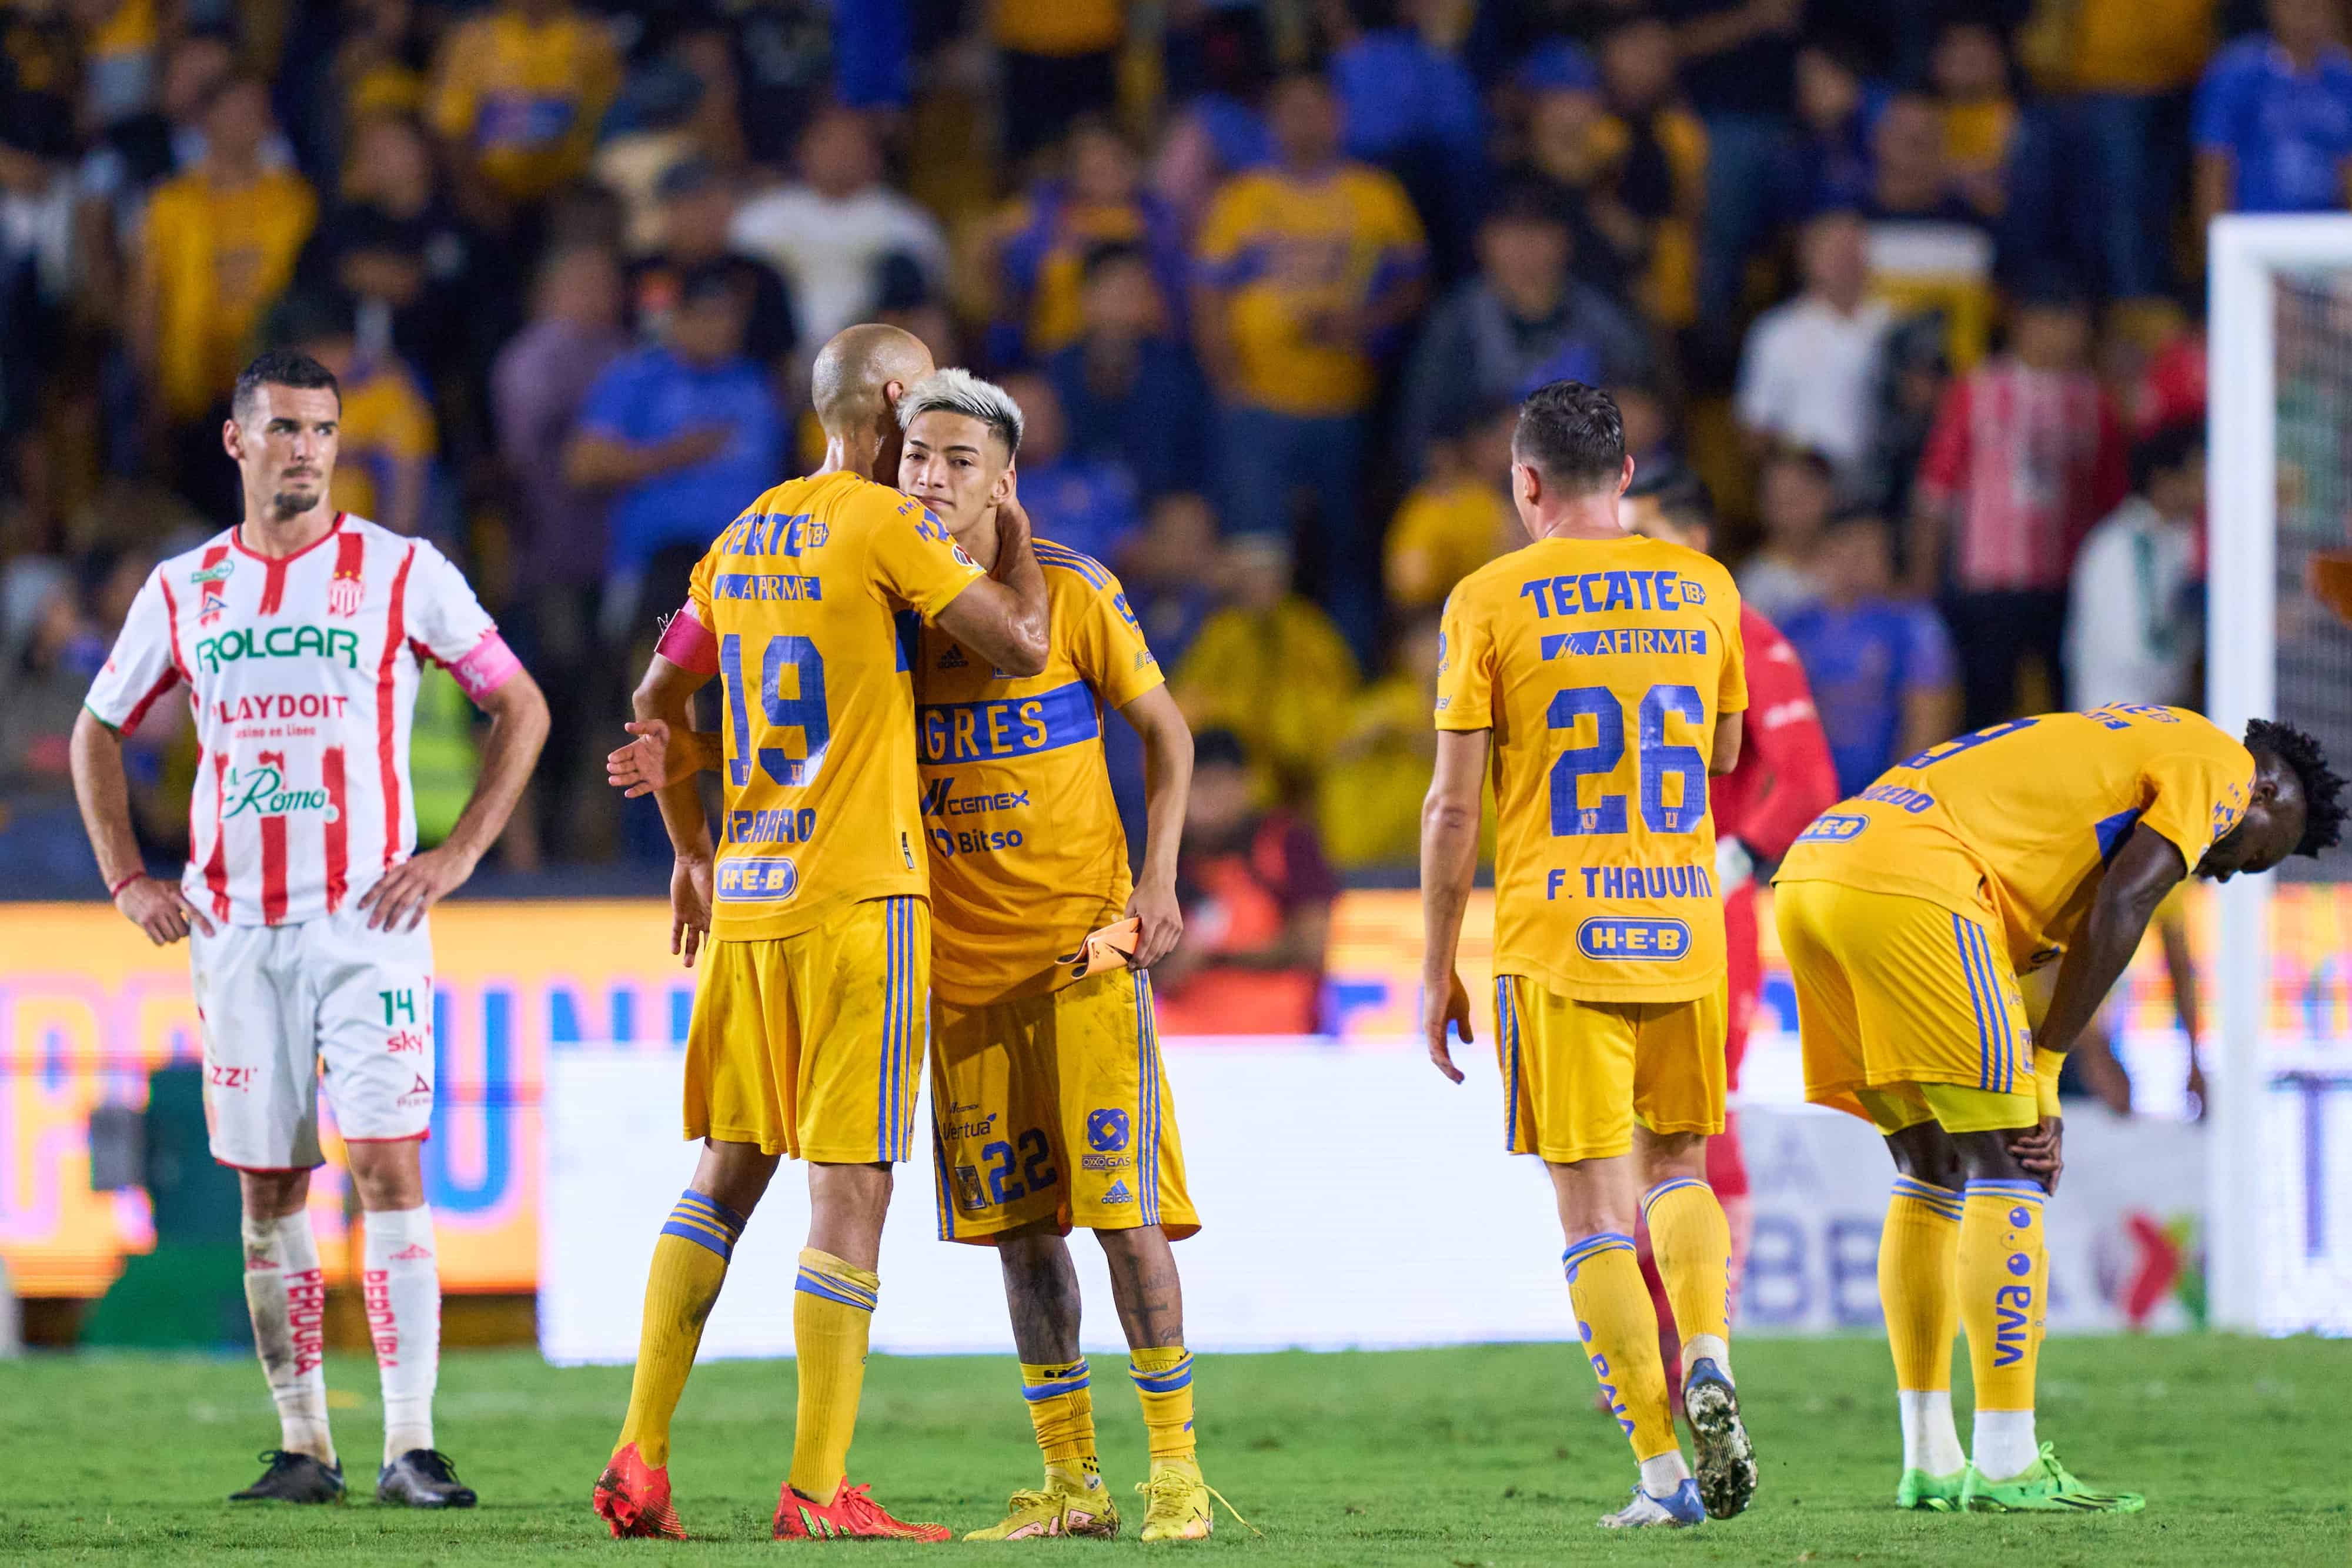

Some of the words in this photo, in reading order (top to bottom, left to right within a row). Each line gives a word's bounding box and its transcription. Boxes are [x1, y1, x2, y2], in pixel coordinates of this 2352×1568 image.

[1521, 571, 1680, 618] TECATE
[1683, 583, 1705, 604] 18+
[196, 625, 359, 674] ROLCAR
[1594, 630, 1699, 655] AFIRME
[213, 694, 349, 724] LAYDOIT
[720, 633, 830, 787] 19
[918, 701, 1048, 761] GRES
[1546, 684, 1705, 837] 26
[947, 790, 1030, 815] CEMEX
[960, 829, 1023, 853] Bitso
[1548, 868, 1573, 900] F.
[1580, 865, 1712, 898] THAUVIN
[379, 988, 415, 1026] 14
[387, 1029, 423, 1055] sky
[981, 1128, 1057, 1205] 22
[1994, 1285, 2032, 1368] viva
